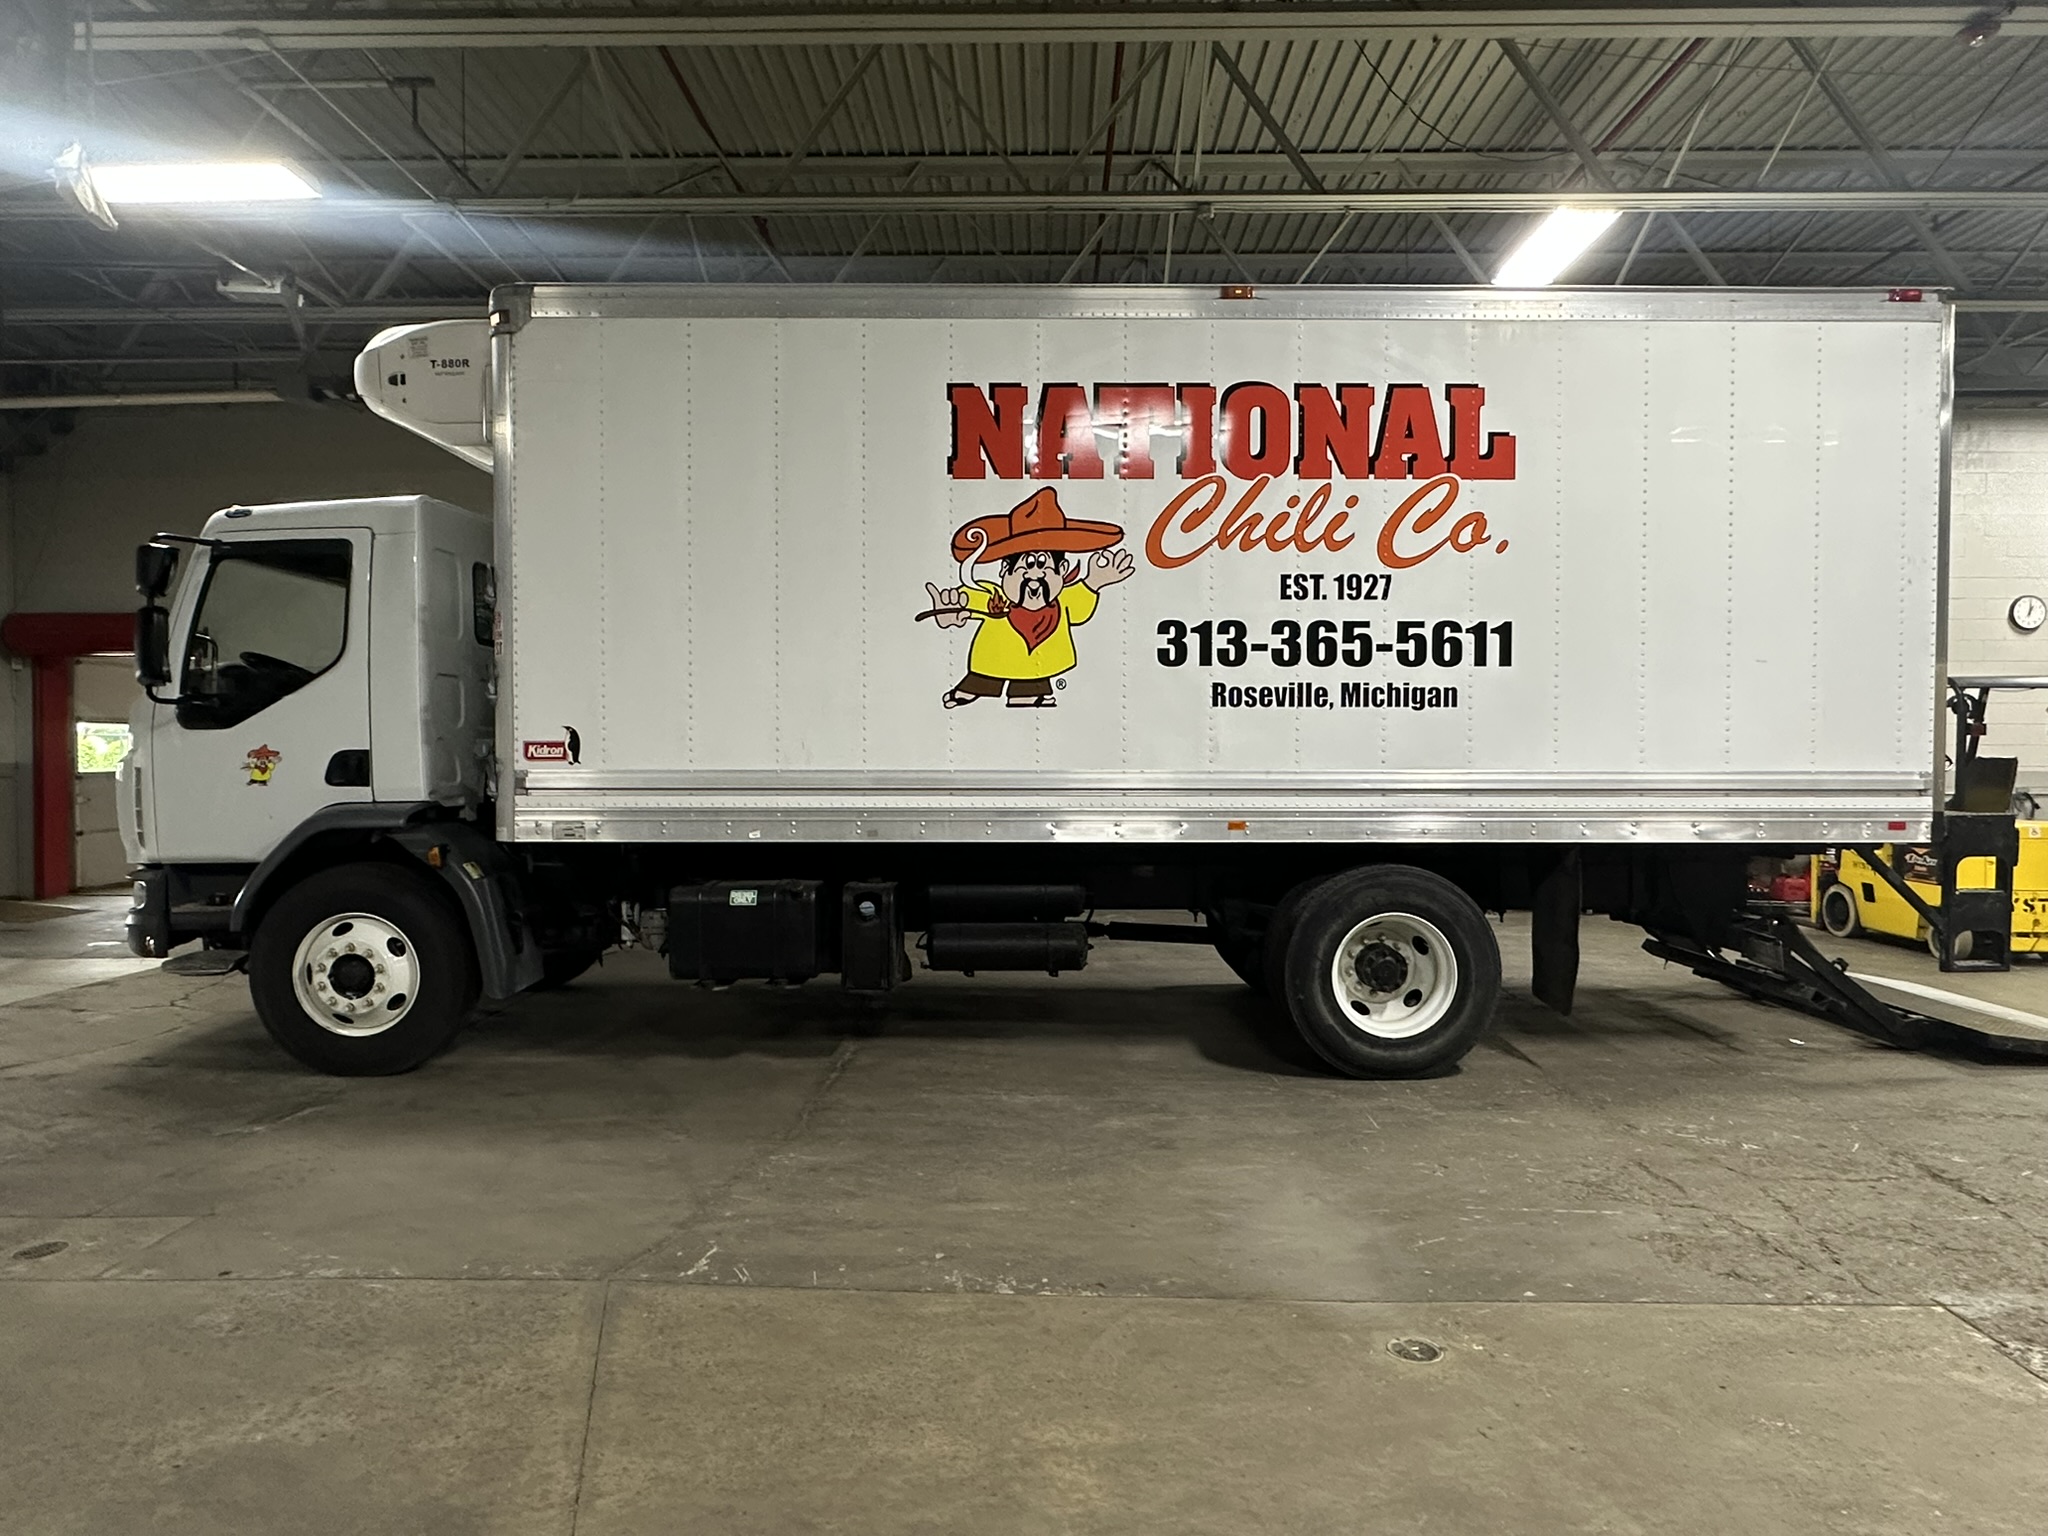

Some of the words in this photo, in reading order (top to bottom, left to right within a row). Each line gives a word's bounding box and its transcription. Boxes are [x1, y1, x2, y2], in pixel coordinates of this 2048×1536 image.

[430, 359, 470, 369] T-880R
[946, 381, 1517, 480] NATIONAL
[1145, 475, 1359, 570] Chili
[1377, 475, 1509, 570] Co.
[1280, 573, 1328, 601] EST.
[1333, 573, 1392, 601] 1927
[1156, 619, 1513, 668] 313-365-5611
[1211, 682, 1334, 711] Roseville,
[1340, 682, 1458, 711] Michigan
[527, 744, 564, 758] Kidron
